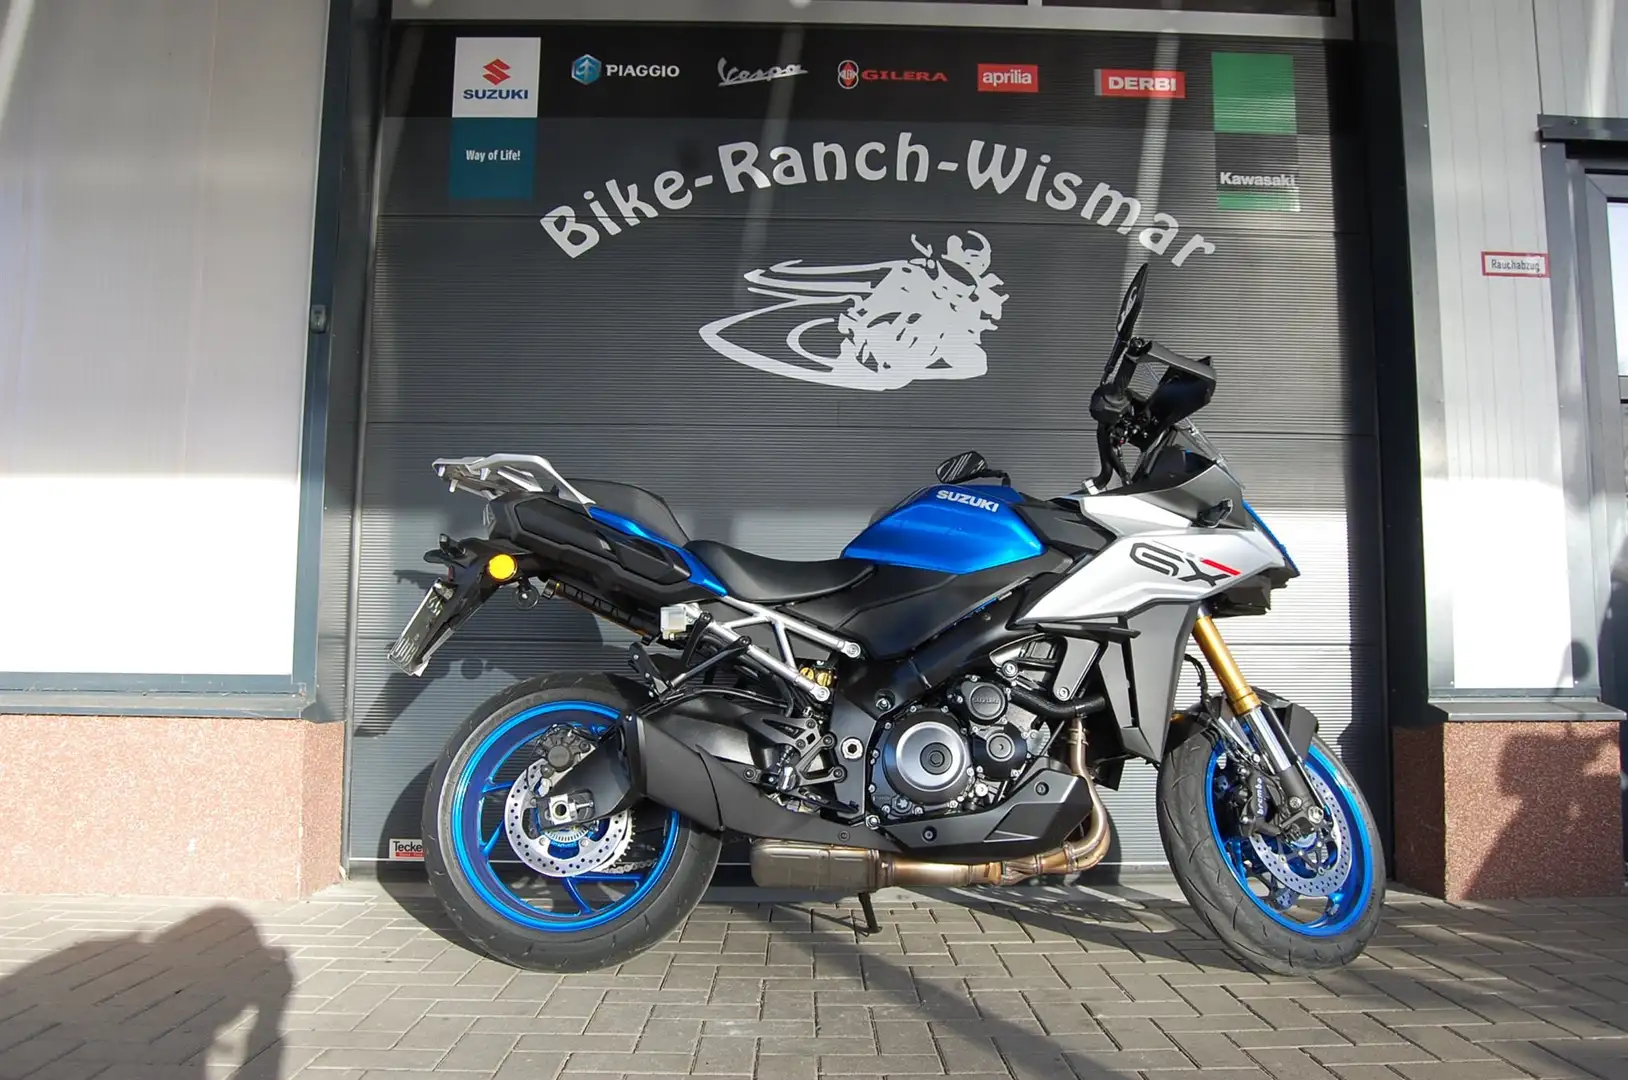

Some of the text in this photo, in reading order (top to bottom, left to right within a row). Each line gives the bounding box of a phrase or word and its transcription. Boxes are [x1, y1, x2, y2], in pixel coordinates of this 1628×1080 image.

[605, 64, 680, 77] PIAGGIO
[717, 57, 809, 87] Vespa
[861, 69, 948, 82] GILERA
[983, 69, 1032, 87] aprilia
[1108, 76, 1177, 92] DERBI
[463, 89, 529, 99] SUZUKI
[465, 149, 521, 163] Way of Life!
[1220, 171, 1296, 186] Kawasaki
[1491, 259, 1541, 273] Rauchabzug
[936, 489, 1000, 513] SUZUKI
[1254, 777, 1264, 815] brembo
